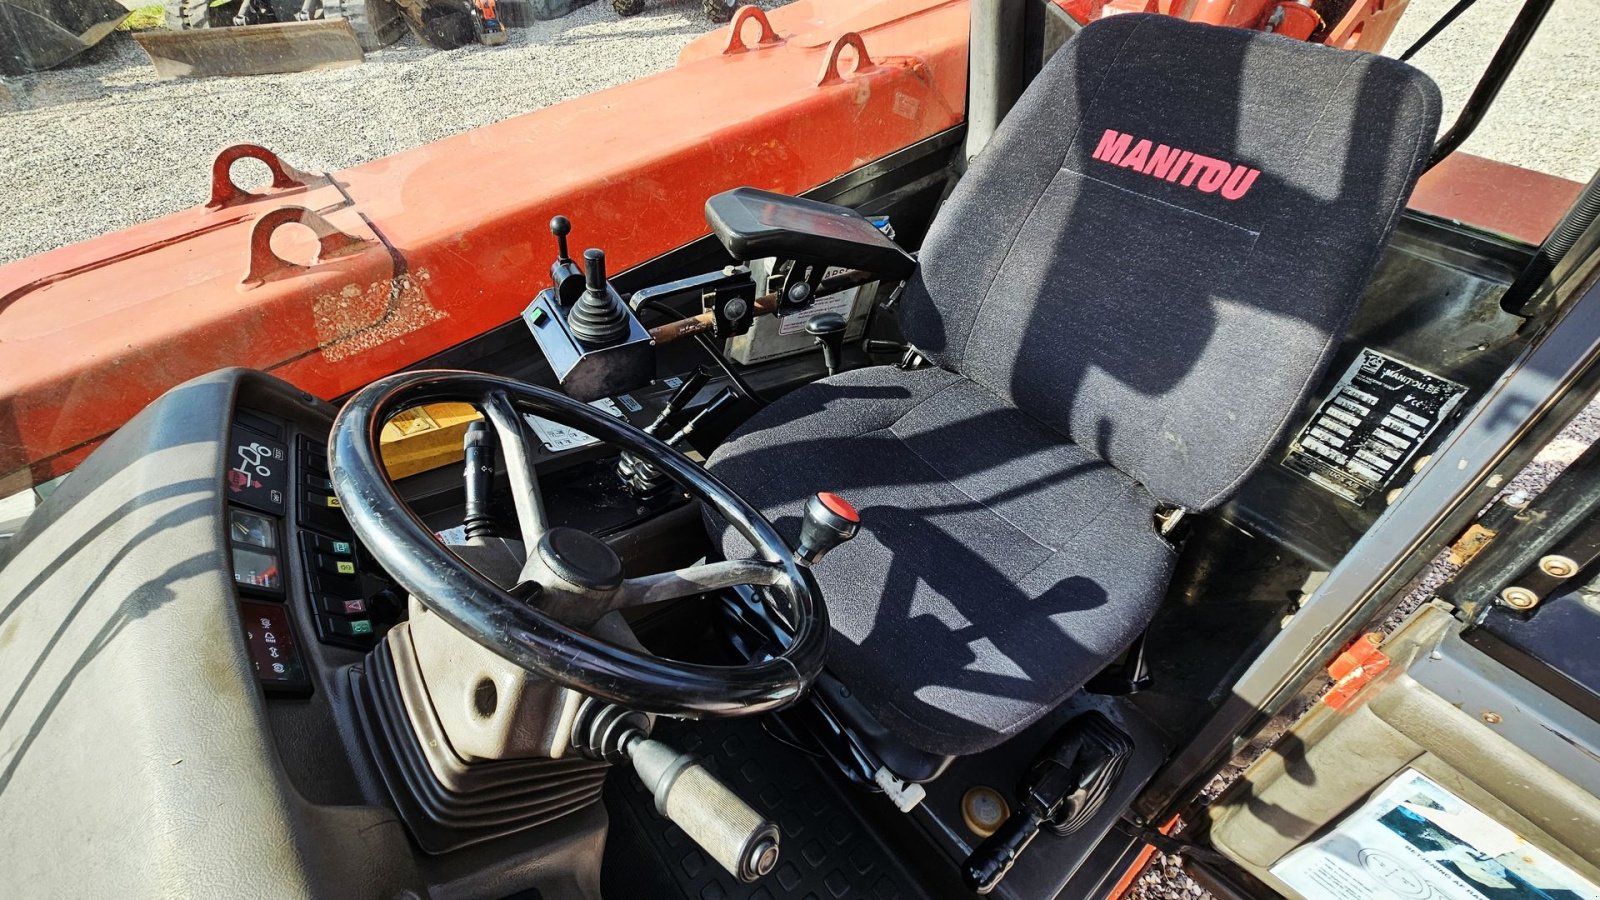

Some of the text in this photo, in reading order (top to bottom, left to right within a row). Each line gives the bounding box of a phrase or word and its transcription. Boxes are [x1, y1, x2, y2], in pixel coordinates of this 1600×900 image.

[1092, 129, 1261, 200] MANITOU
[1385, 369, 1426, 389] MANITOU
[1404, 844, 1452, 879] BETJENING
